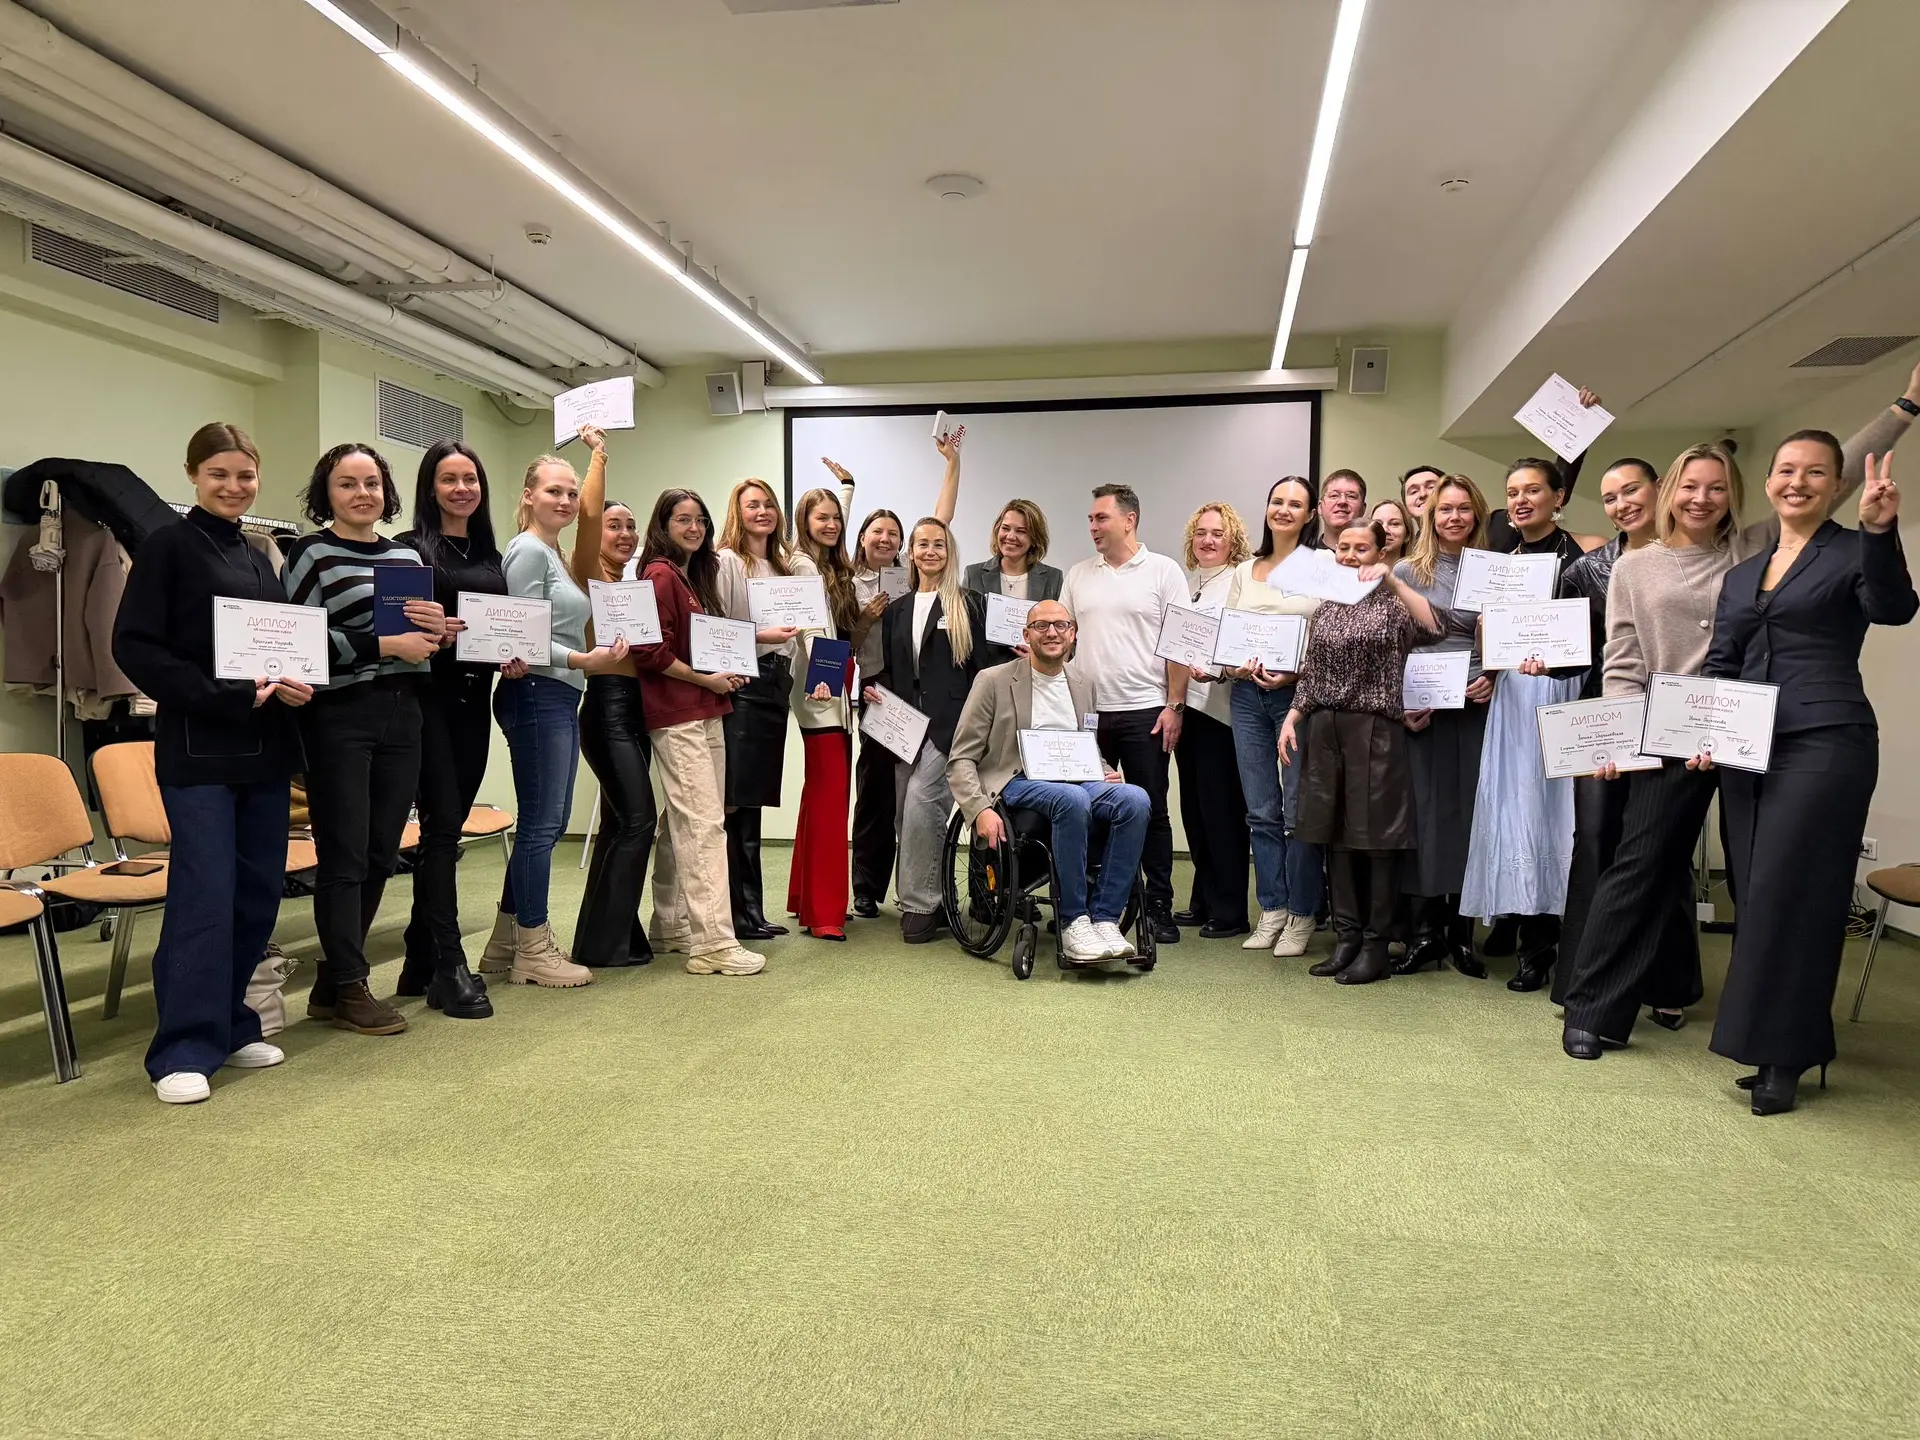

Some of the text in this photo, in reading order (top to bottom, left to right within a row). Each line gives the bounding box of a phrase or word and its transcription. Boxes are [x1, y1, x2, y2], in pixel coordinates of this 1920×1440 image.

[1487, 564, 1530, 574] ДИПЛОМ
[769, 586, 804, 595] ДИПЛОМ
[484, 607, 527, 619] ДИПЛОМ
[1512, 614, 1559, 624] ДИПЛОМ
[247, 616, 298, 630] ДИПЛОМ
[1182, 620, 1213, 636] ДИПЛОМ
[1410, 663, 1448, 673] ДИПЛОМ
[1684, 693, 1741, 709] ДИПЛОМ
[1571, 711, 1622, 727] ДИПЛОМ
